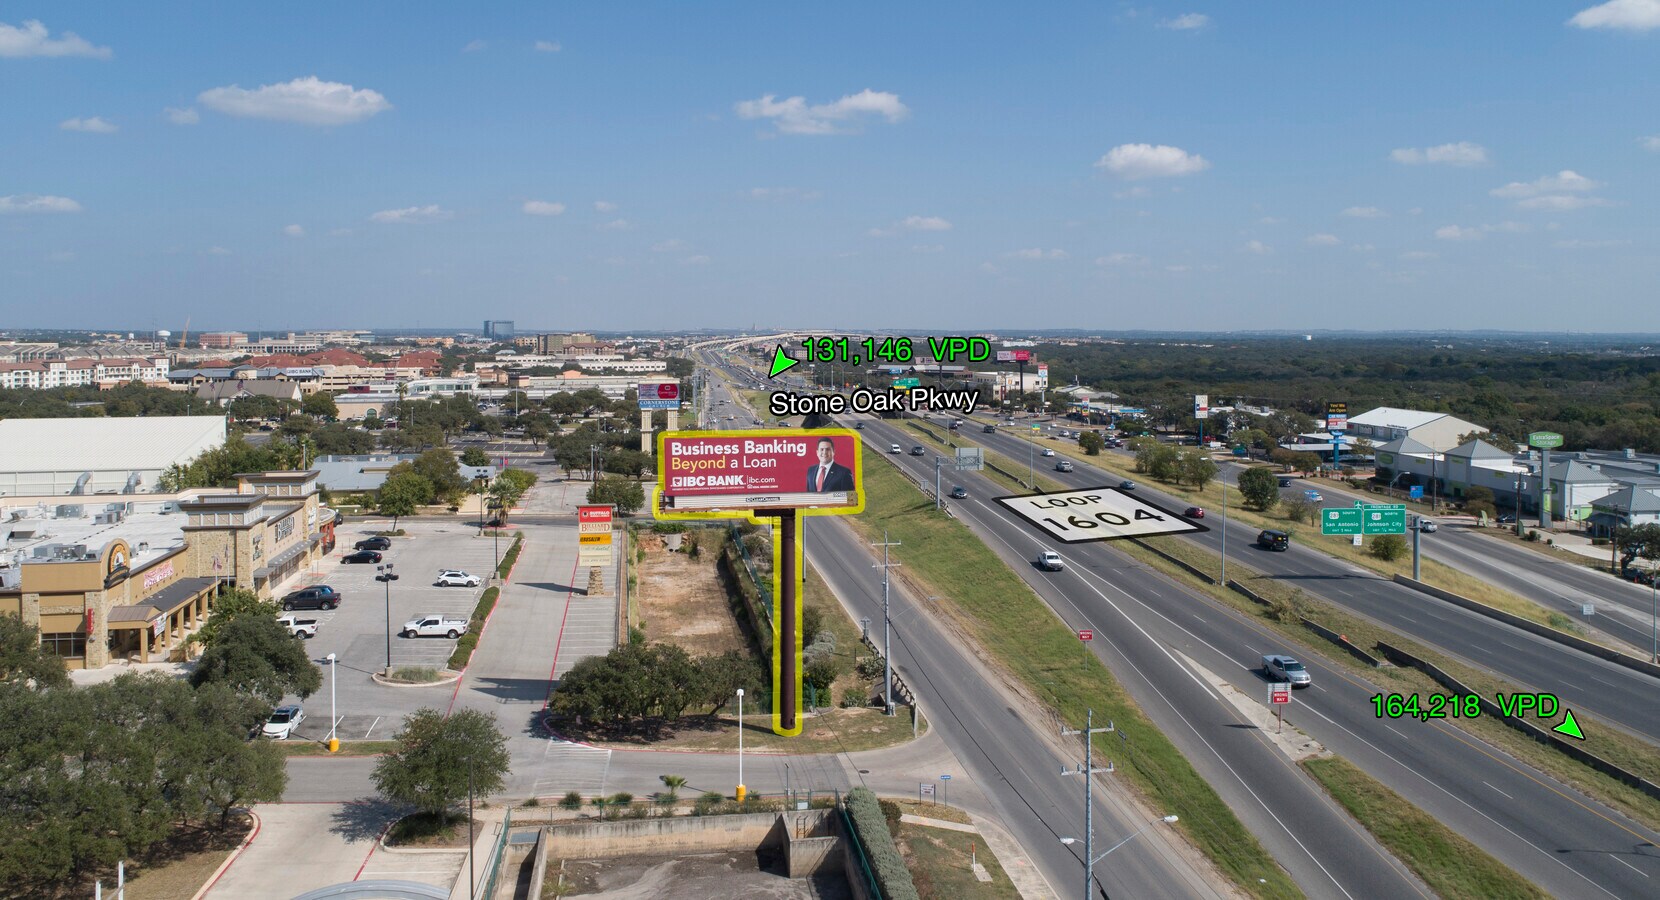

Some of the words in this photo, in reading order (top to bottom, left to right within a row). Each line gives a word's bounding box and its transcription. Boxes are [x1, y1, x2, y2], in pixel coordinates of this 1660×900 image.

[671, 441, 739, 456] Business
[744, 439, 806, 456] Banking
[672, 456, 726, 473] Beyond
[730, 459, 738, 469] a
[743, 456, 777, 469] Loan
[683, 476, 706, 487] IBC
[708, 474, 745, 486] BANK
